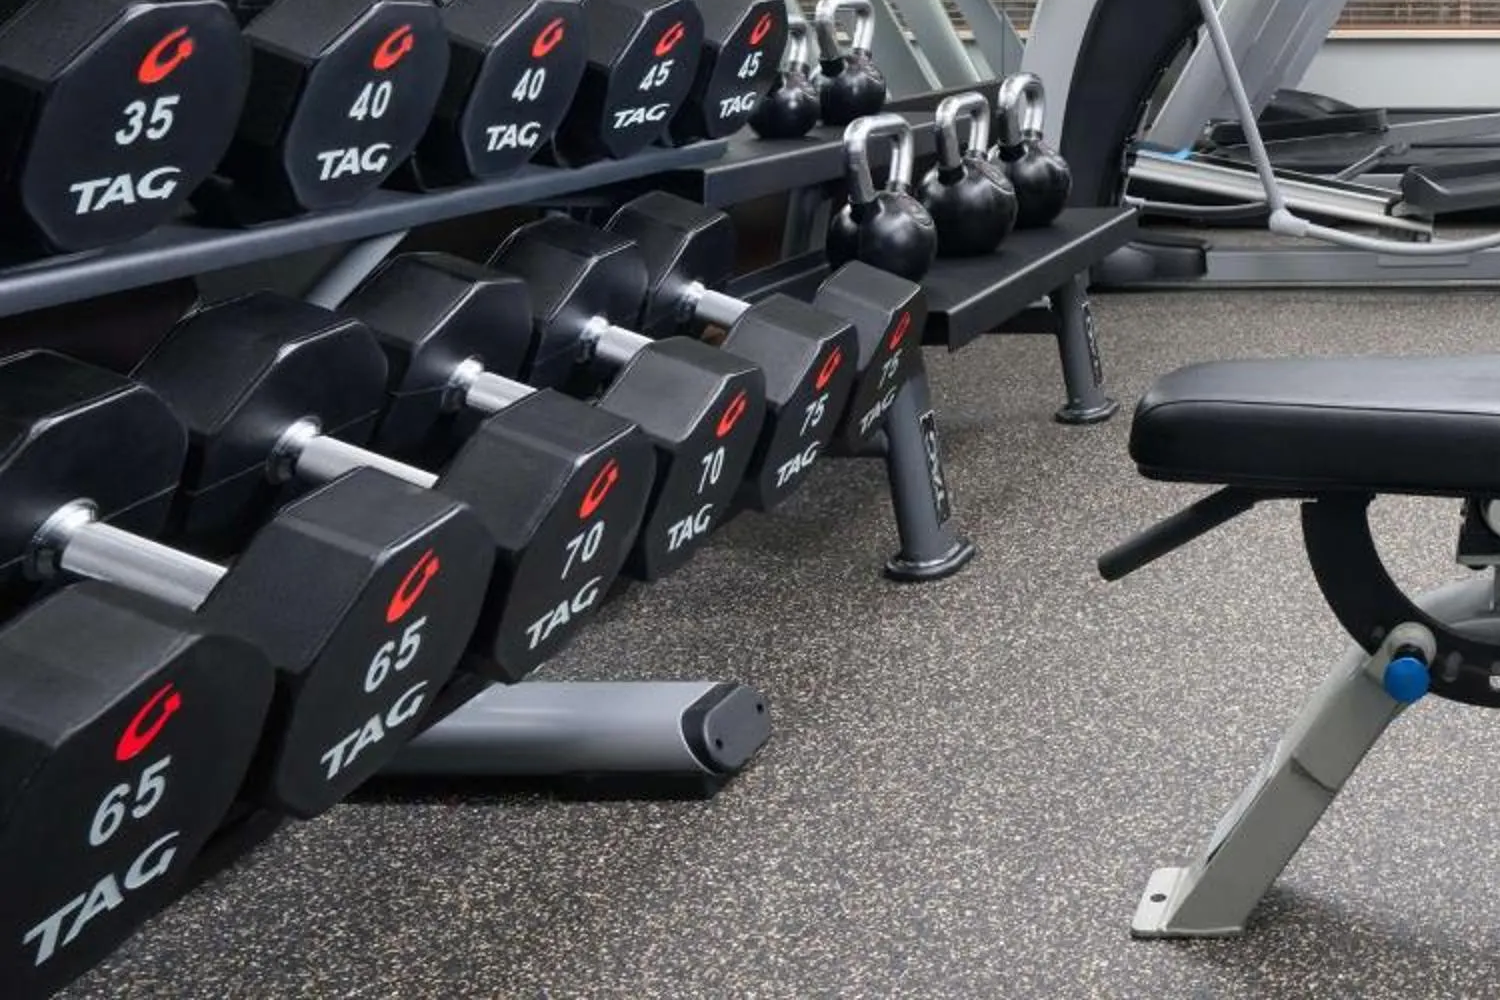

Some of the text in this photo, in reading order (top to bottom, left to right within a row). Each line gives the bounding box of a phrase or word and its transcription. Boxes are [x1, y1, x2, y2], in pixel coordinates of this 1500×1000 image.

[512, 68, 545, 101] 40
[640, 60, 673, 90] 45
[738, 52, 762, 78] 45
[116, 96, 179, 144] 35
[350, 81, 392, 120] 40
[614, 104, 669, 128] TAG
[720, 92, 756, 117] TAG
[487, 122, 540, 150] TAG
[318, 144, 390, 180] TAG
[71, 167, 180, 214] TAG
[879, 349, 902, 389] 75
[800, 392, 829, 437] 75
[860, 386, 897, 435] TAG
[699, 446, 726, 494] 70
[776, 440, 821, 488] TAG
[562, 519, 605, 580] 70
[669, 504, 712, 550] TAG
[526, 576, 602, 651] TAG
[365, 616, 428, 693] 65
[320, 680, 427, 780] TAG
[88, 756, 172, 848] 65
[23, 831, 179, 968] TAG
